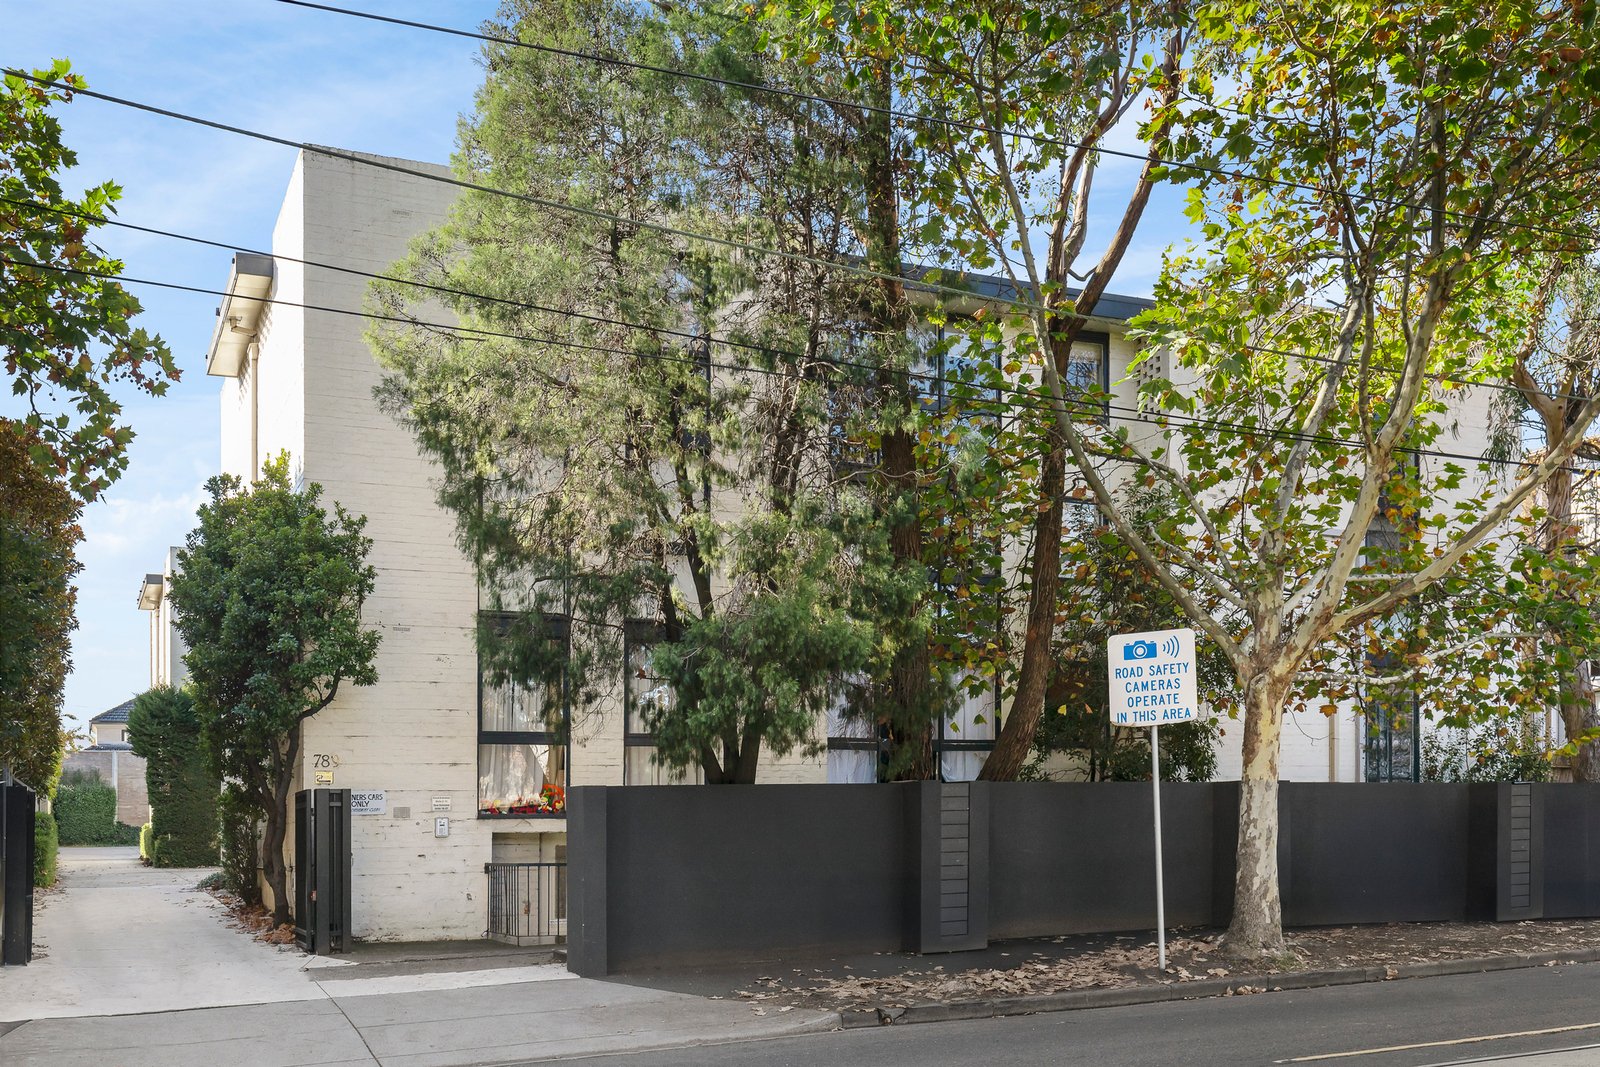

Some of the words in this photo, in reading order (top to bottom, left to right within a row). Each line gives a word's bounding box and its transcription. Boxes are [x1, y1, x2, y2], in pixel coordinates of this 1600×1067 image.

[1115, 666, 1143, 679] ROAD
[1149, 662, 1189, 676] SAFETY
[1125, 678, 1180, 693] CAMERAS
[1127, 693, 1180, 708] OPERATE
[1116, 712, 1127, 723] IN
[1132, 710, 1157, 722] THIS
[1163, 707, 1191, 720] AREA
[351, 800, 370, 808] ONLY
[367, 793, 383, 801] CARS
